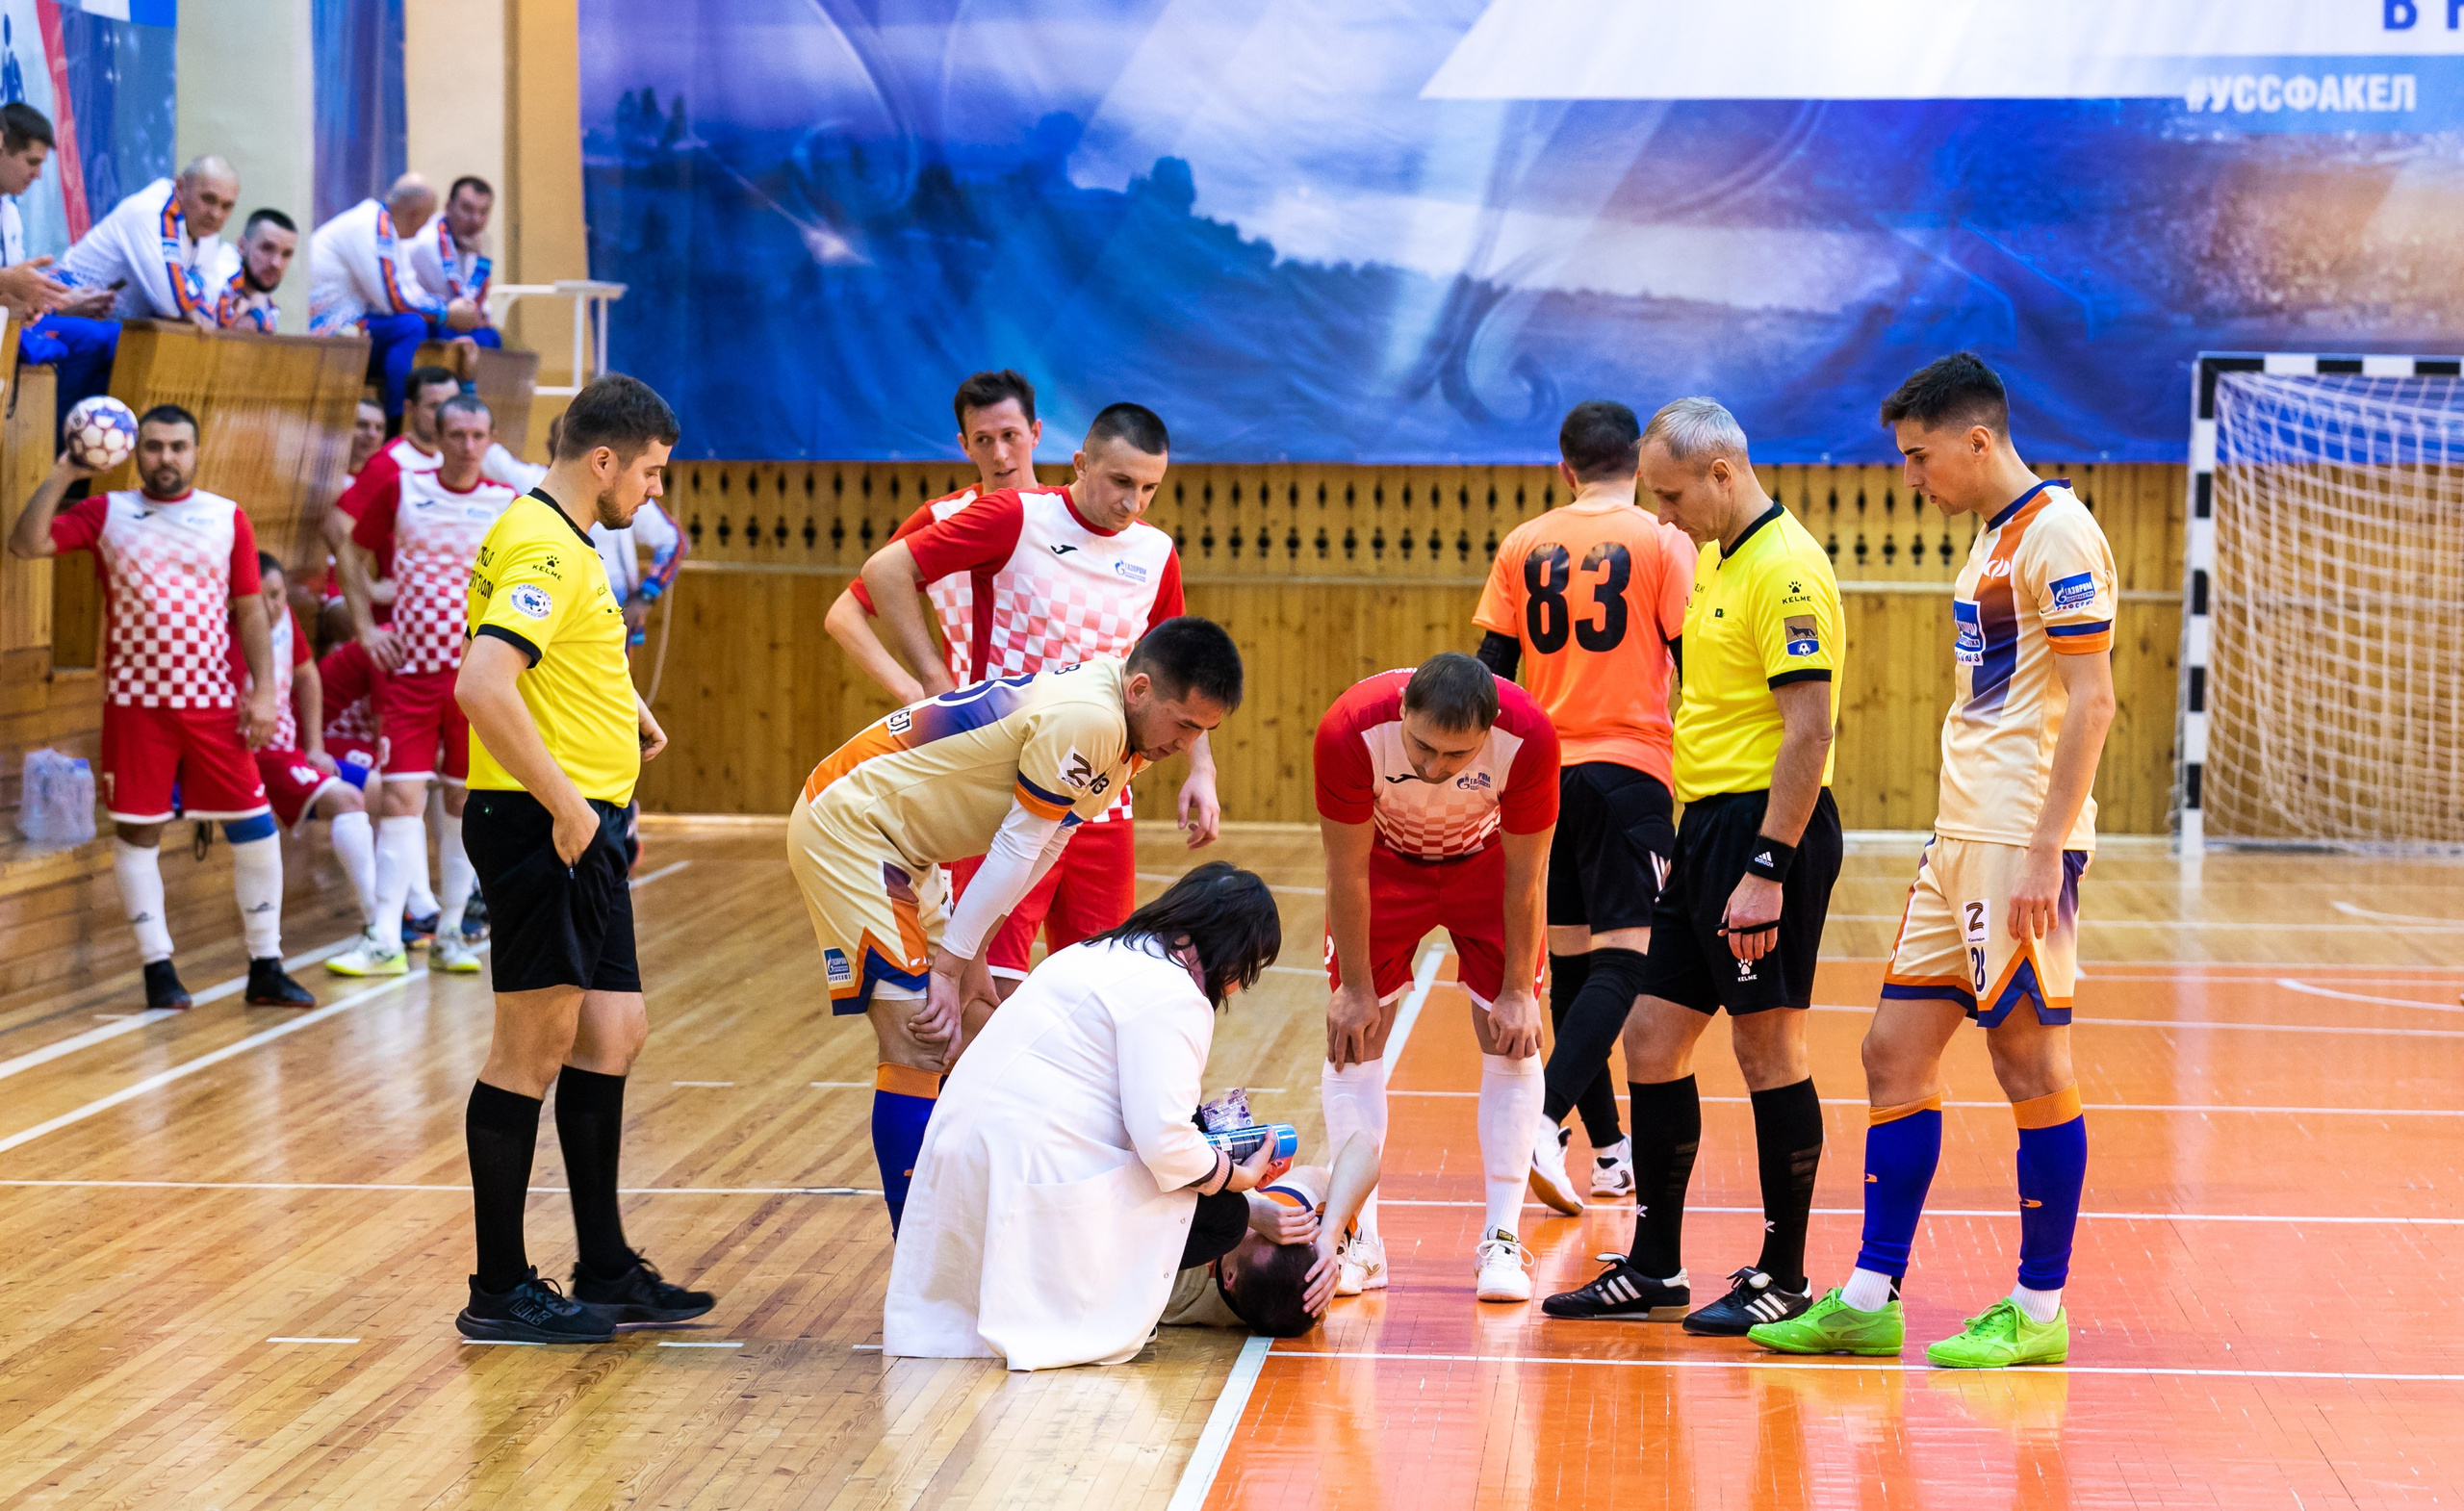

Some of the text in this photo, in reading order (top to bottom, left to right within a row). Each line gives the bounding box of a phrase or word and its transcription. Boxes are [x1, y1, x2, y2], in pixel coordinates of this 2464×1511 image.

[2185, 74, 2416, 113] #УССФАКЕЛ
[531, 563, 563, 582] KELME
[1524, 541, 1631, 654] 83
[1781, 595, 1812, 605] KELME
[1736, 974, 1758, 983] KELME
